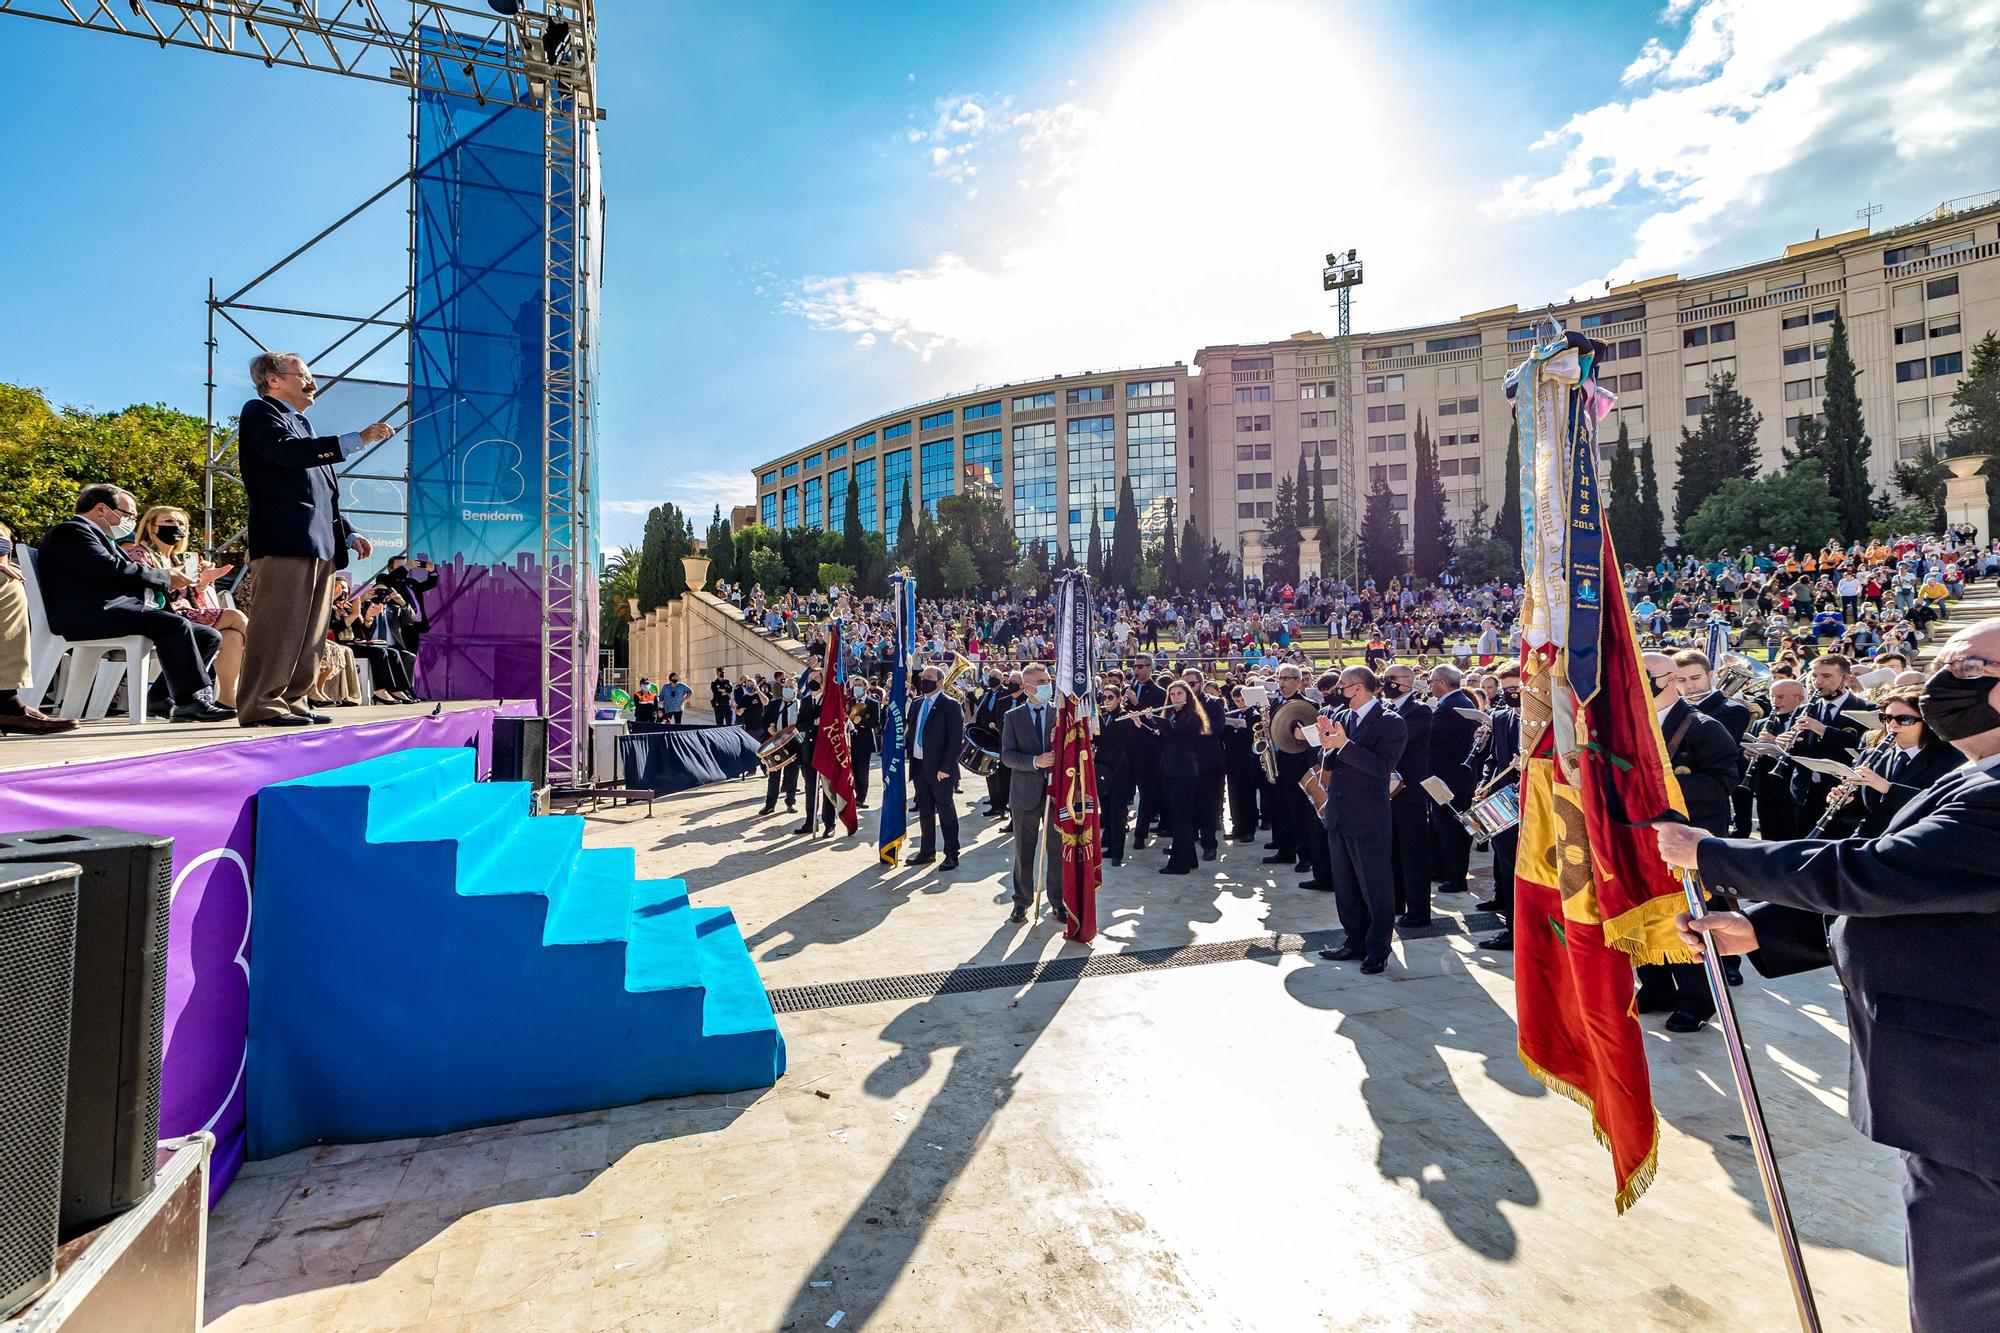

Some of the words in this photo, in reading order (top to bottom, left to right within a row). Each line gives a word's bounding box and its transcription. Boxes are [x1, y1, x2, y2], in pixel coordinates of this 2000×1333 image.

[1580, 425, 1591, 515] Reinas
[462, 509, 524, 521] Benidorm
[1572, 519, 1594, 530] 2015
[1076, 634, 1084, 669] BENIDORM
[888, 700, 904, 749] MUSICAL
[888, 757, 900, 773] LA
